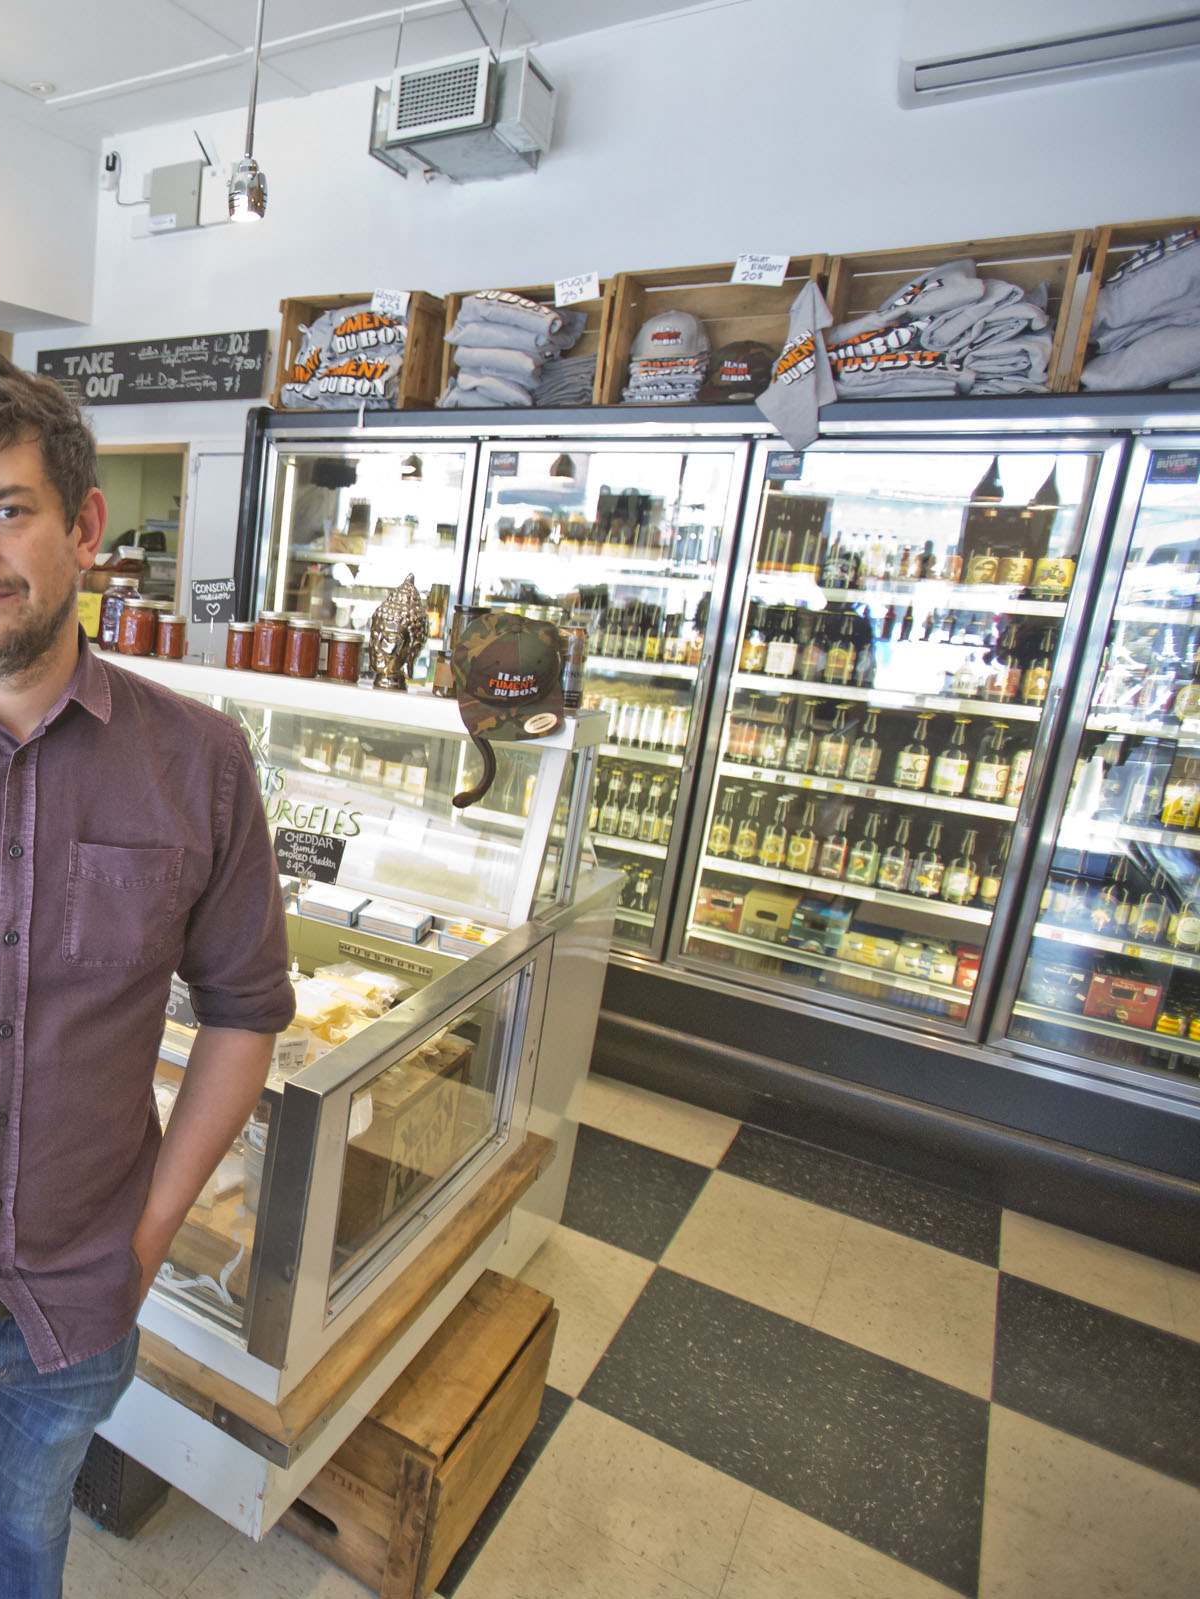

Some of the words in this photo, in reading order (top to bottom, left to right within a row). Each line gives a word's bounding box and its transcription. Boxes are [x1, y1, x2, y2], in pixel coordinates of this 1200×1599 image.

[64, 351, 114, 376] TAKE
[86, 373, 124, 398] OUT
[489, 678, 536, 690] FUMENT
[285, 831, 334, 850] CHEDDAR
